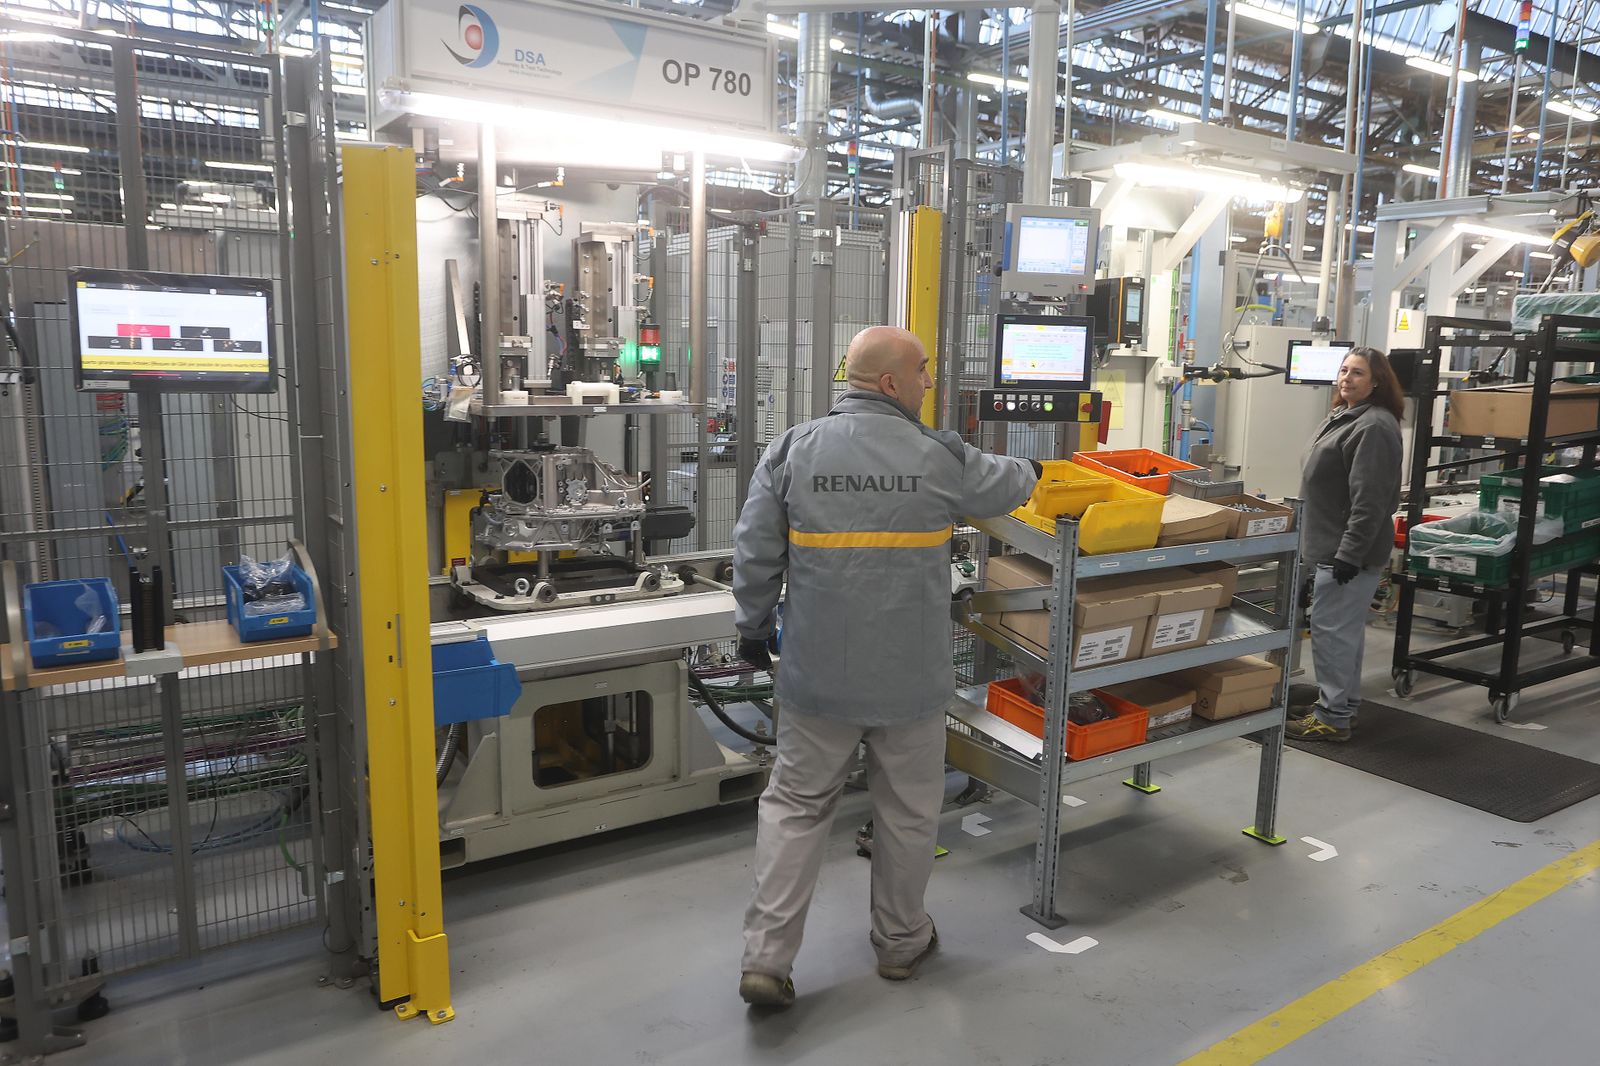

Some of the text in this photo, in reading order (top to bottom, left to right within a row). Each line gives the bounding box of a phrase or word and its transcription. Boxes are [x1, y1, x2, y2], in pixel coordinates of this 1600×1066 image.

[515, 49, 546, 65] DSA
[662, 59, 751, 96] OP 780
[813, 475, 922, 492] RENAULT
